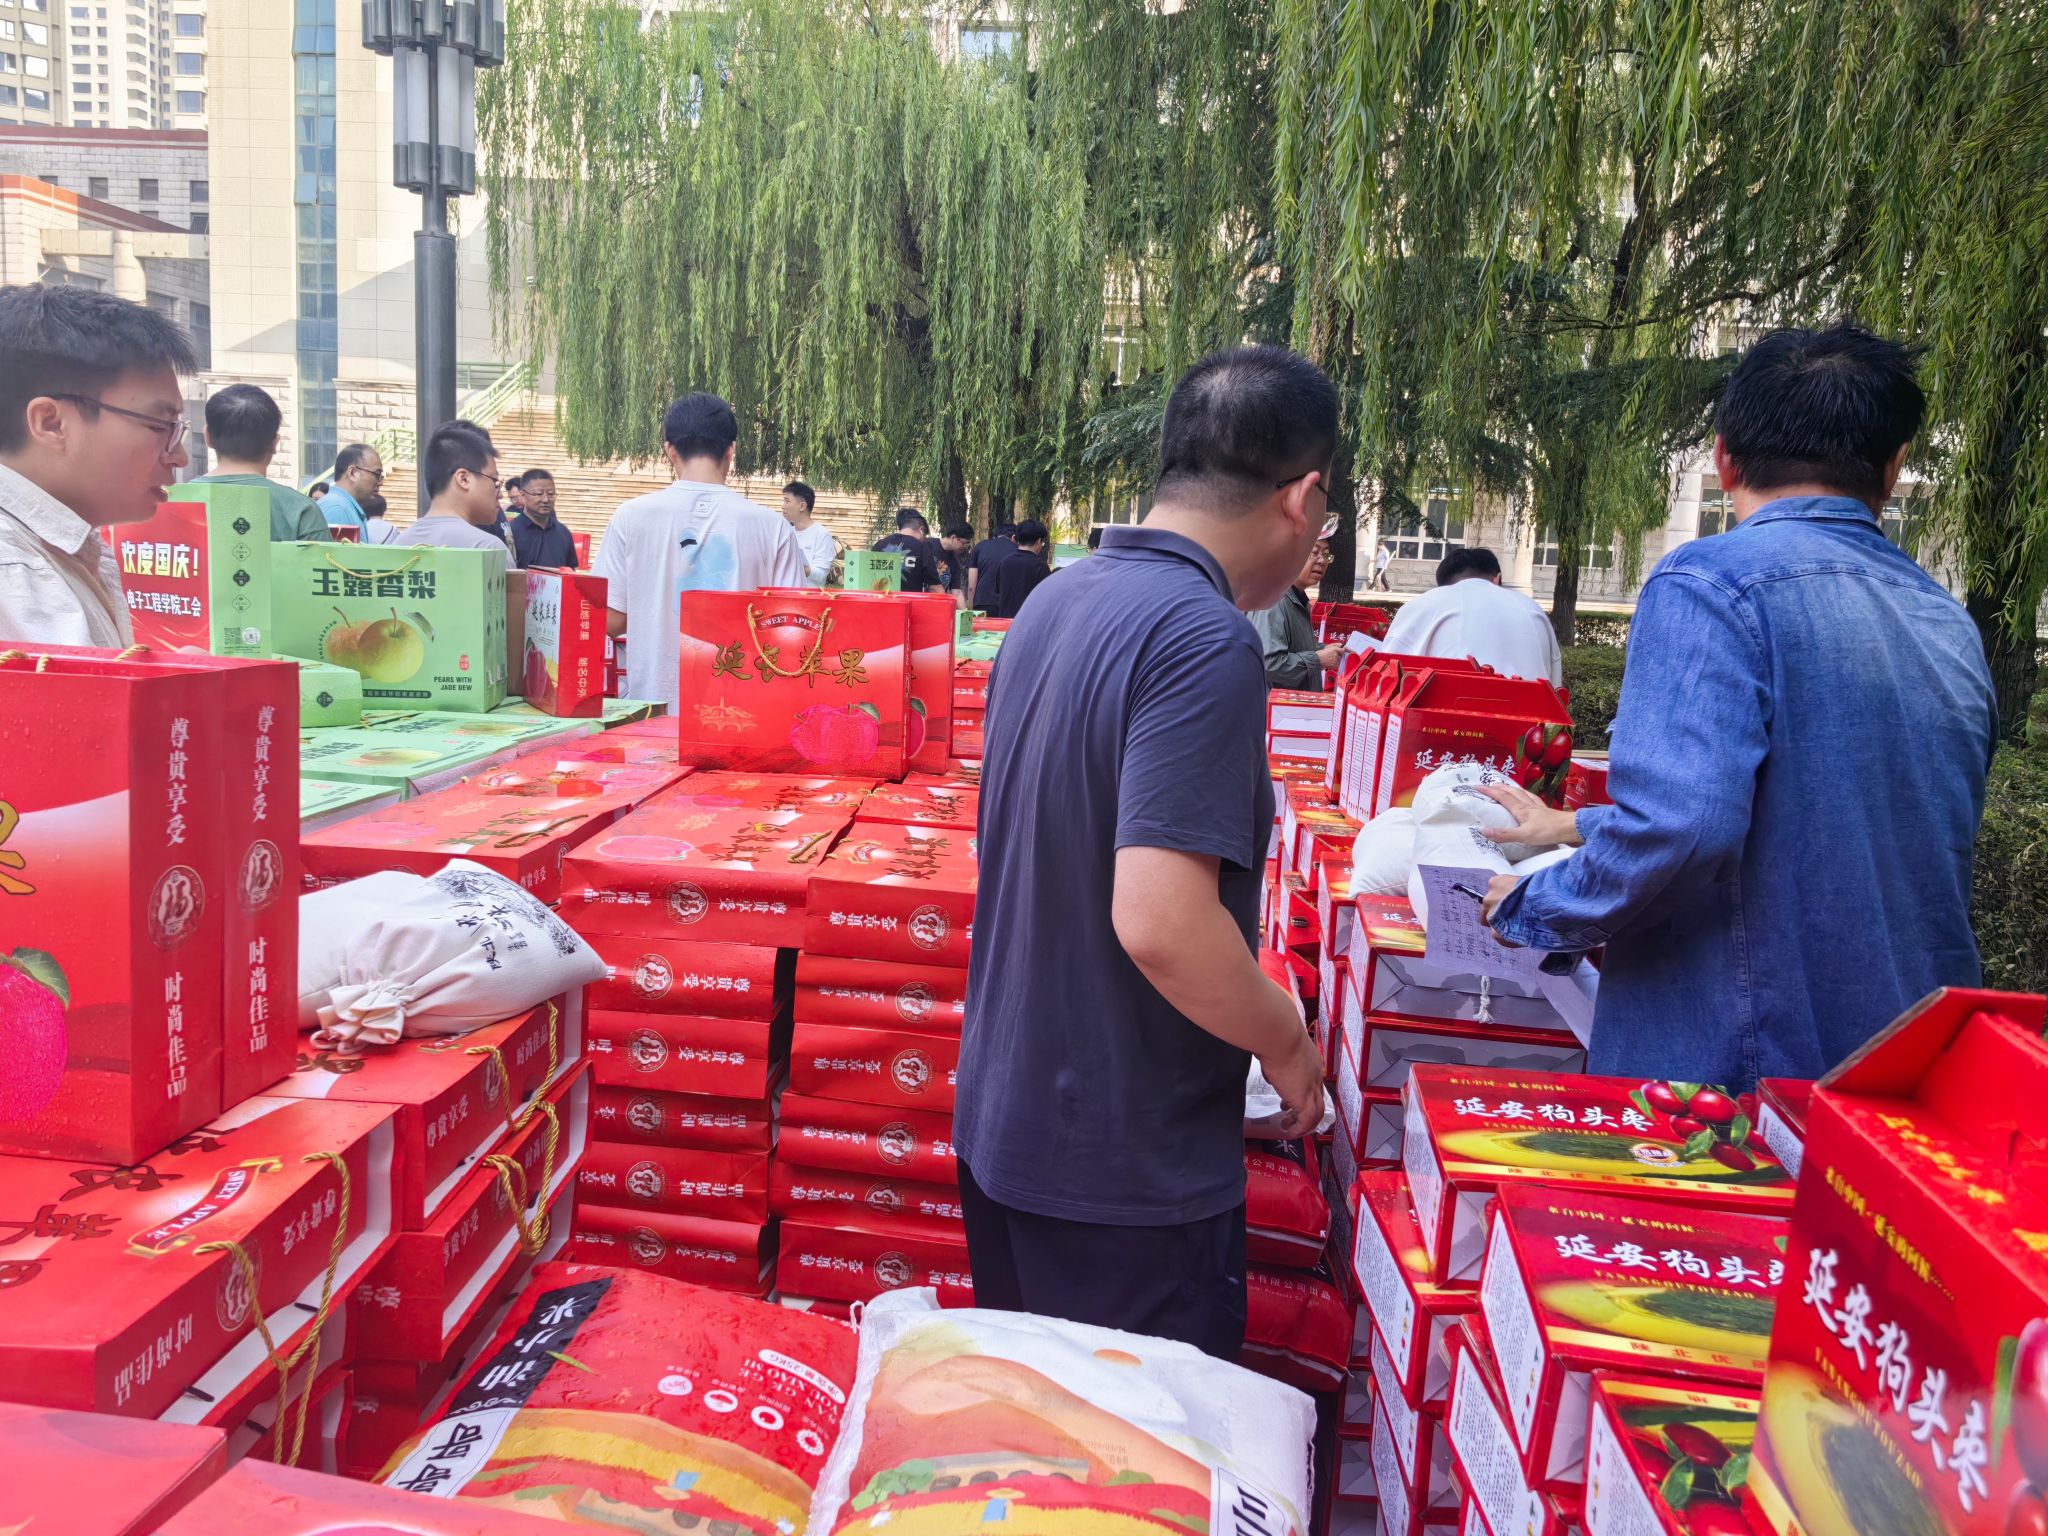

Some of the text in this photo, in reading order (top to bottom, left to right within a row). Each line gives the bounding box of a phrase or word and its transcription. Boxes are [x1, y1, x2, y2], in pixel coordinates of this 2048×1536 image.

[121, 541, 199, 579] 欢度国庆！
[311, 567, 437, 600] 玉露香梨
[126, 589, 202, 618] 电子工程学院工会
[760, 615, 821, 632] SWEET APPLE
[433, 676, 472, 684] PEARS WITH
[166, 717, 191, 848] 尊贵享受
[252, 704, 276, 824] 尊贵享受
[829, 910, 899, 932] 尊贵享受
[248, 936, 270, 1055] 时尚佳品
[165, 971, 189, 1101] 时尚佳品
[1454, 1097, 1654, 1132] 延安狗头枣
[146, 1170, 247, 1241] SWEET APPLE
[113, 1312, 194, 1407] 时尚佳品
[1802, 1248, 1989, 1514] 延安狗头枣
